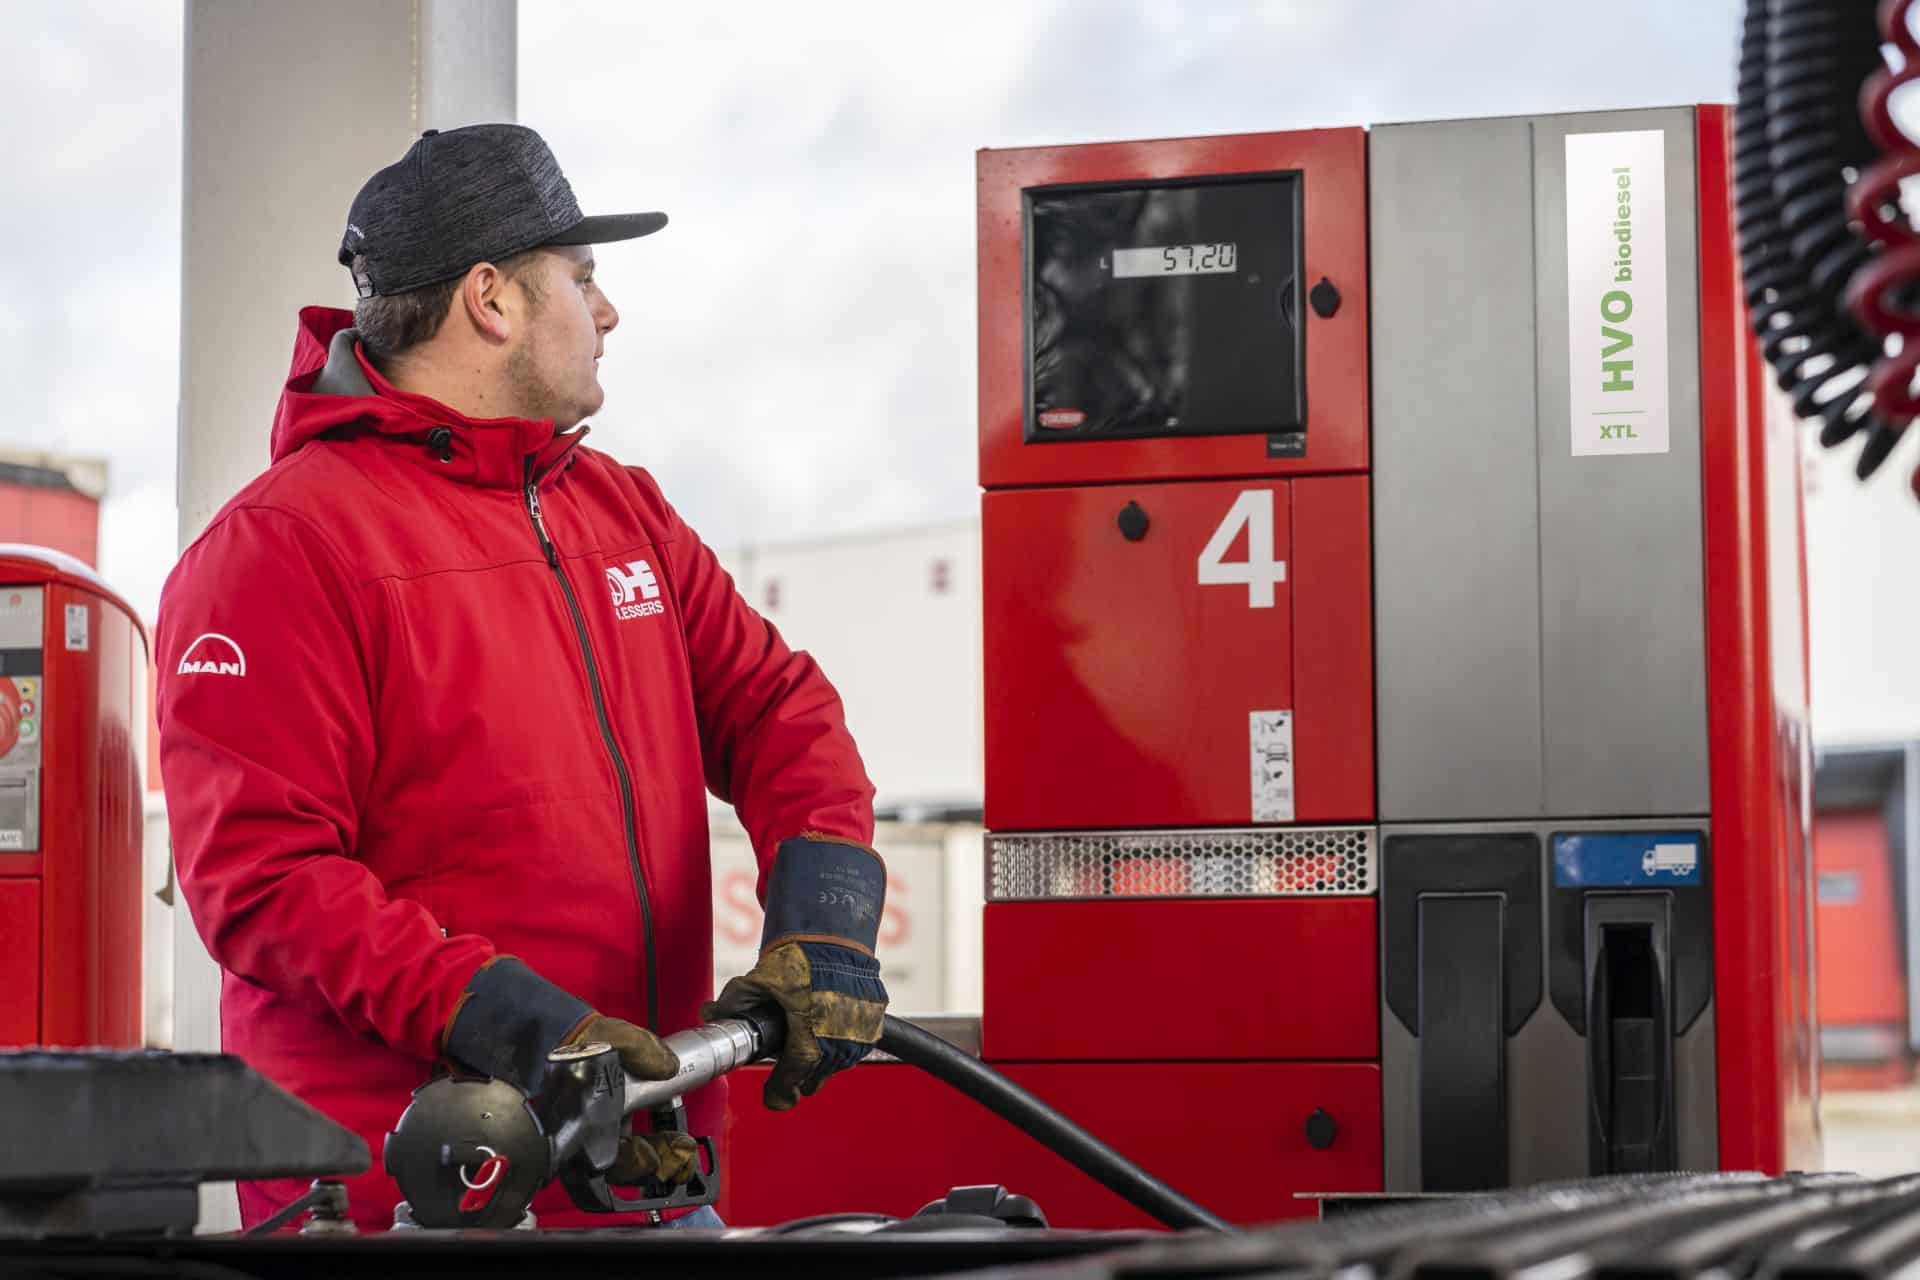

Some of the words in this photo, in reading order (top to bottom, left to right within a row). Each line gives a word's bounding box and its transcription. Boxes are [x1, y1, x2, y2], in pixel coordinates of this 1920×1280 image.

[1163, 242, 1234, 272] 57,20
[1612, 166, 1633, 283] biodiesel
[1600, 290, 1634, 393] HVO
[1599, 424, 1638, 441] XTL
[1197, 489, 1286, 609] 4
[182, 660, 240, 677] MAN
